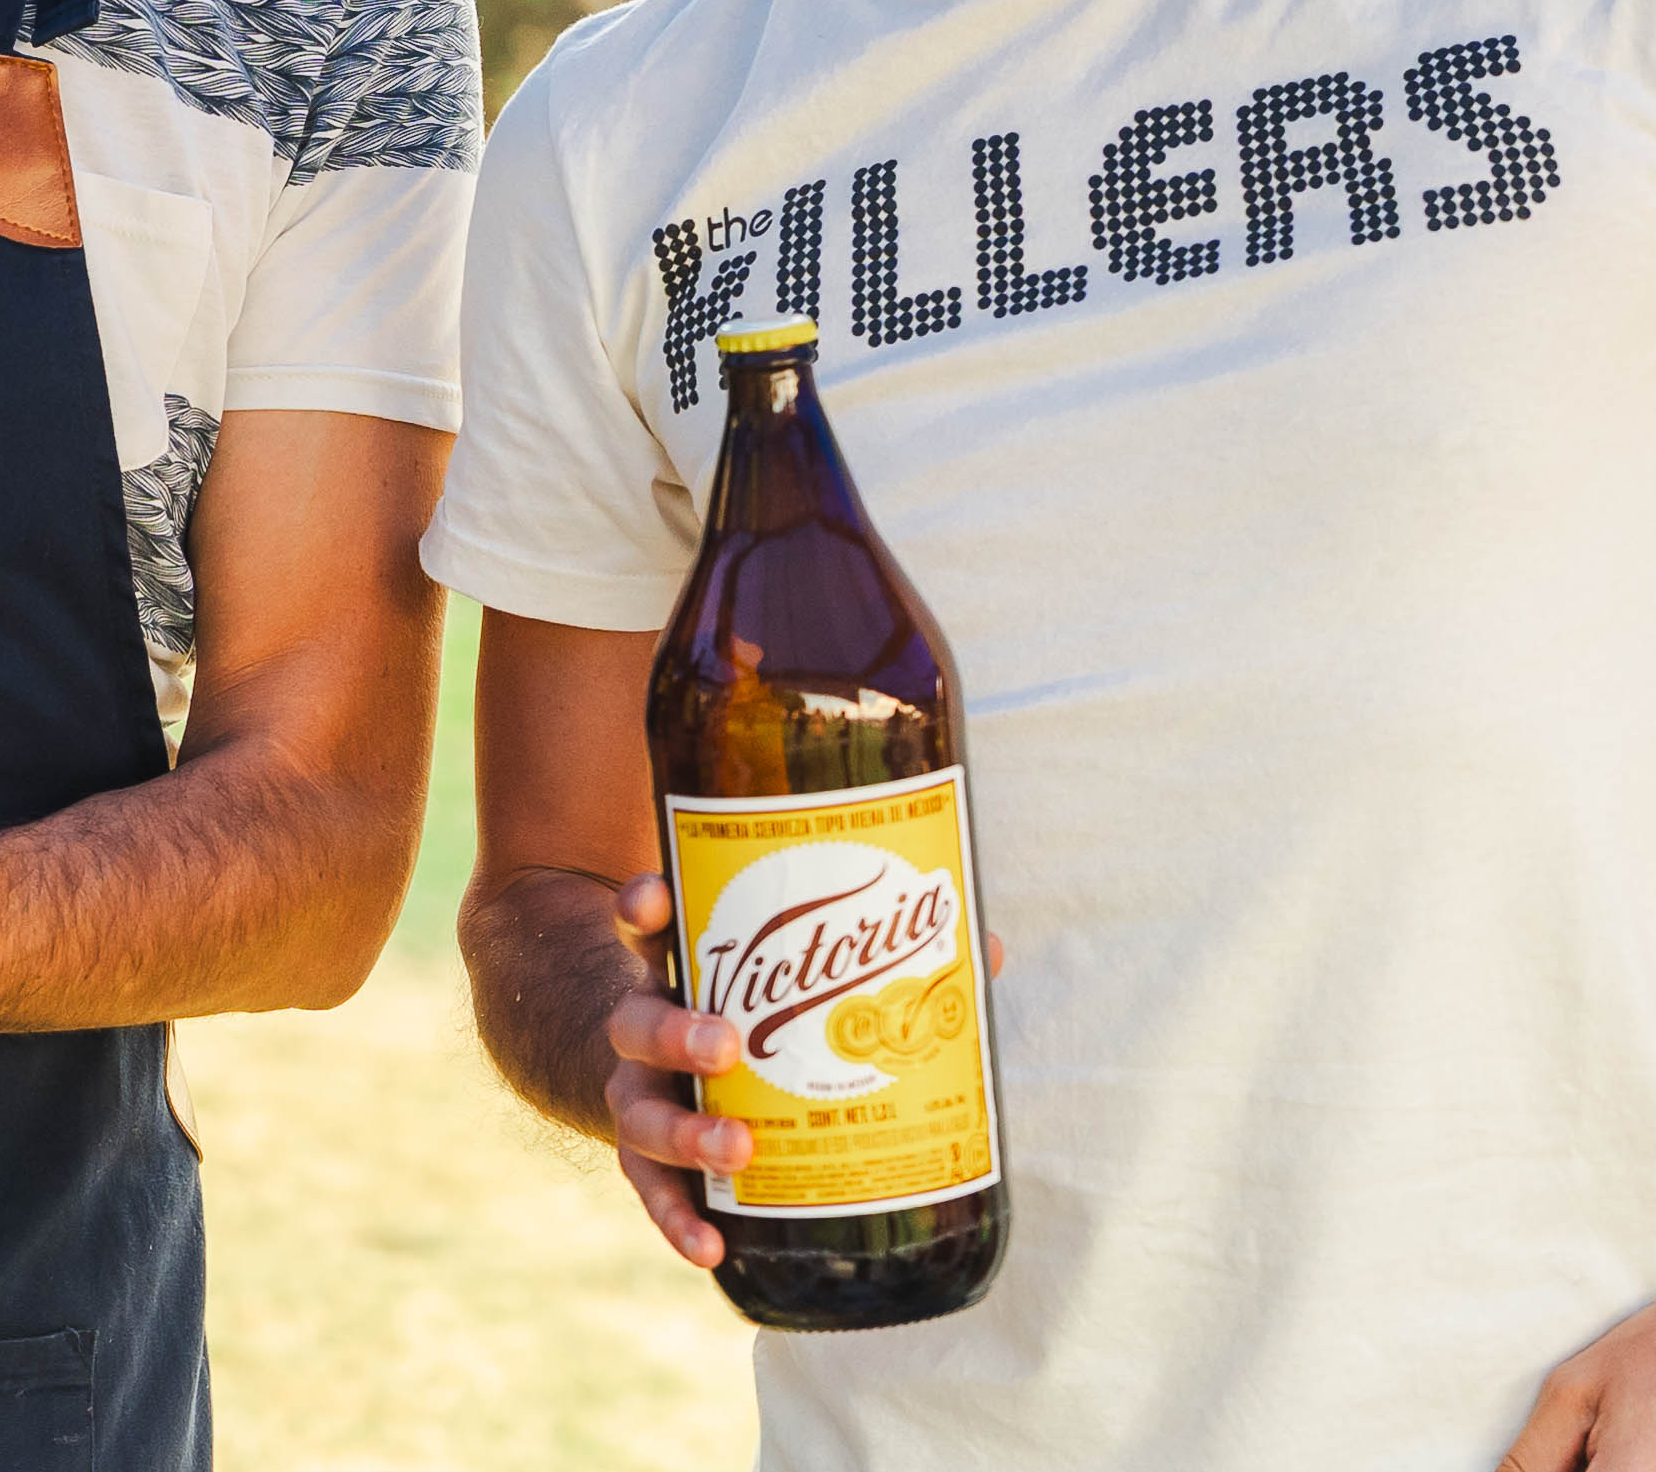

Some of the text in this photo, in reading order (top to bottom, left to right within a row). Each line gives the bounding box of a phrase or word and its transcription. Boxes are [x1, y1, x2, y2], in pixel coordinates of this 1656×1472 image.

[652, 34, 1560, 414] KILLERS
[707, 206, 773, 252] the
[708, 864, 948, 1027] Victoria
